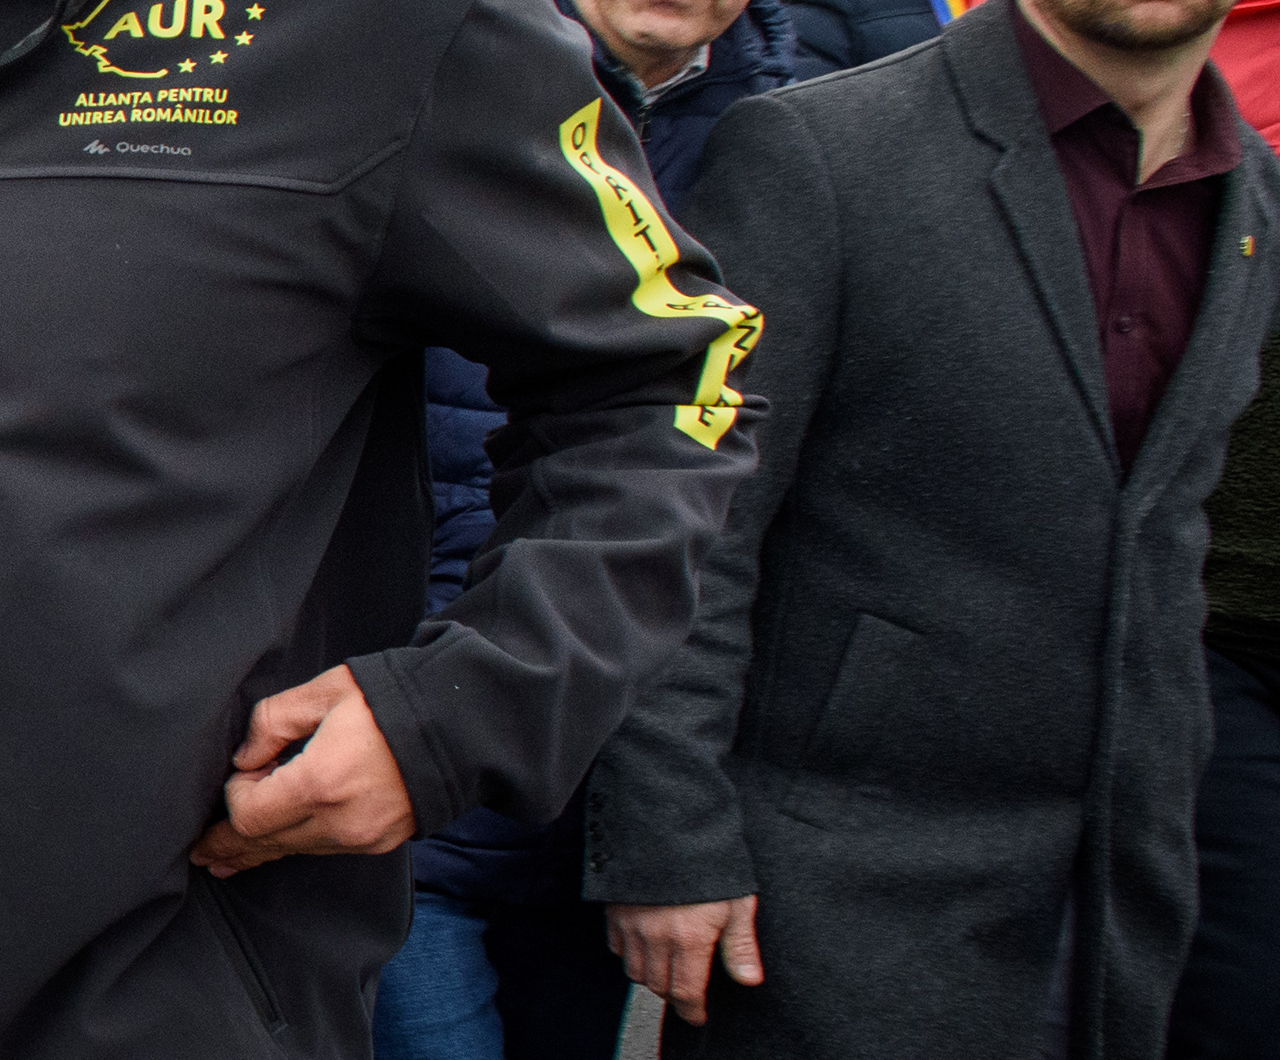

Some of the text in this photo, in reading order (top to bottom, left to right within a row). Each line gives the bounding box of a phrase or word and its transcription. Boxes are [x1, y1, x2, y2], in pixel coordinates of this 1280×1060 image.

[74, 87, 228, 108] ALIANȚA PENTRU
[59, 104, 239, 127] UNIREA ROMÂNILOR
[115, 142, 192, 156] Quechua
